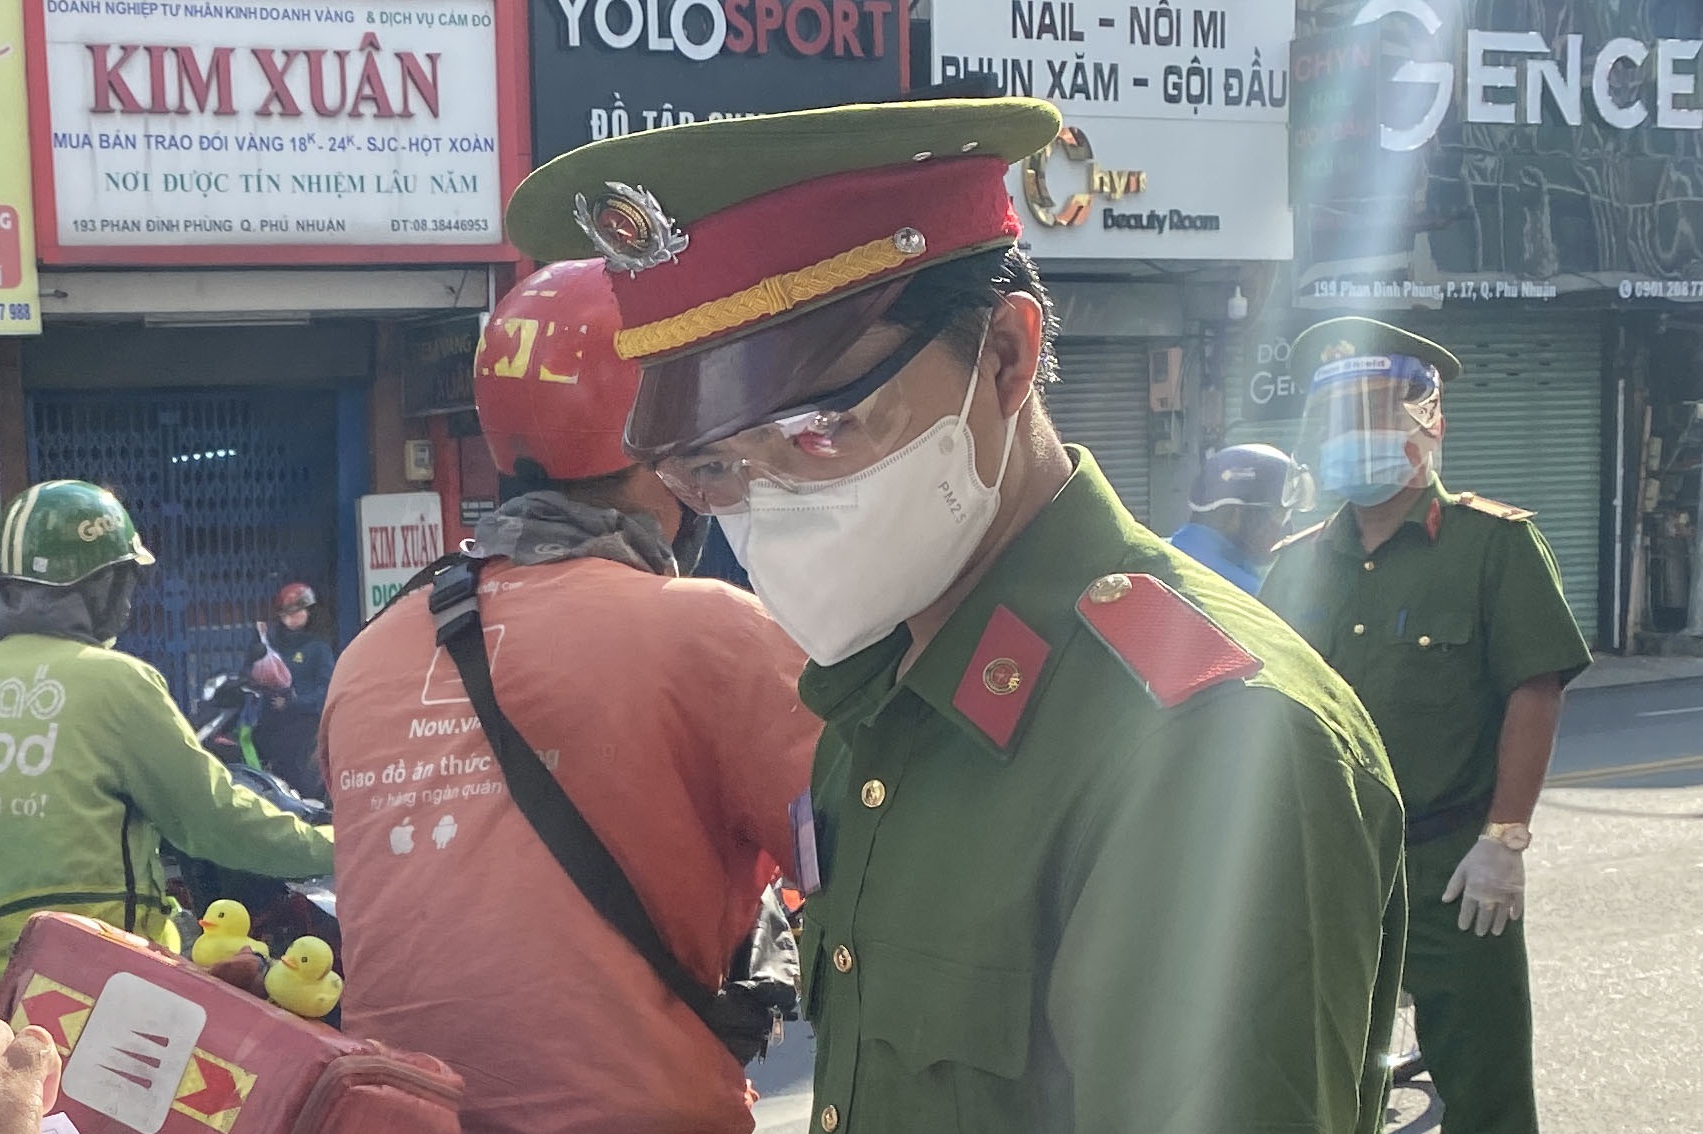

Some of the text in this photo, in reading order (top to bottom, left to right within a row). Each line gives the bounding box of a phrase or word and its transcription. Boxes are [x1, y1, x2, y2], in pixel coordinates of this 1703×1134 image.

[105, 0, 158, 18] NGHIỆP
[162, 2, 182, 17] TƯ
[184, 3, 223, 19] NHÂN
[225, 6, 257, 20] KINH
[260, 7, 311, 22] DOANH
[314, 7, 355, 24] VÀNG
[366, 11, 376, 24] &
[380, 11, 412, 27] DỊCH
[416, 12, 434, 29] VỤ
[1012, 0, 1085, 42] NAIL
[1193, 10, 1226, 49] MI
[85, 31, 443, 119] KIM XUÂN
[1047, 51, 1120, 102] XĂM
[1163, 55, 1213, 115] GỘI
[1224, 46, 1288, 108] ĐẦU
[54, 131, 93, 150] MUA
[99, 129, 137, 150] BÁN
[144, 134, 193, 151] TRAO
[235, 132, 284, 152] VÀNG
[449, 132, 494, 153] XOÀN
[104, 168, 479, 199] NƠI ĐƯỢC TÍN NHIỆM LÂU NĂM
[73, 219, 96, 232] 193
[100, 219, 141, 232] PHAN
[145, 216, 180, 233] ĐÌNH
[184, 215, 233, 233] PHÙNG
[1103, 208, 1220, 235] Beauty Room
[1340, 280, 1371, 298] Phan
[369, 513, 440, 570] KIM XUÂN
[339, 751, 492, 791] Giao đồ ăn thức
[11, 791, 50, 819] có!
